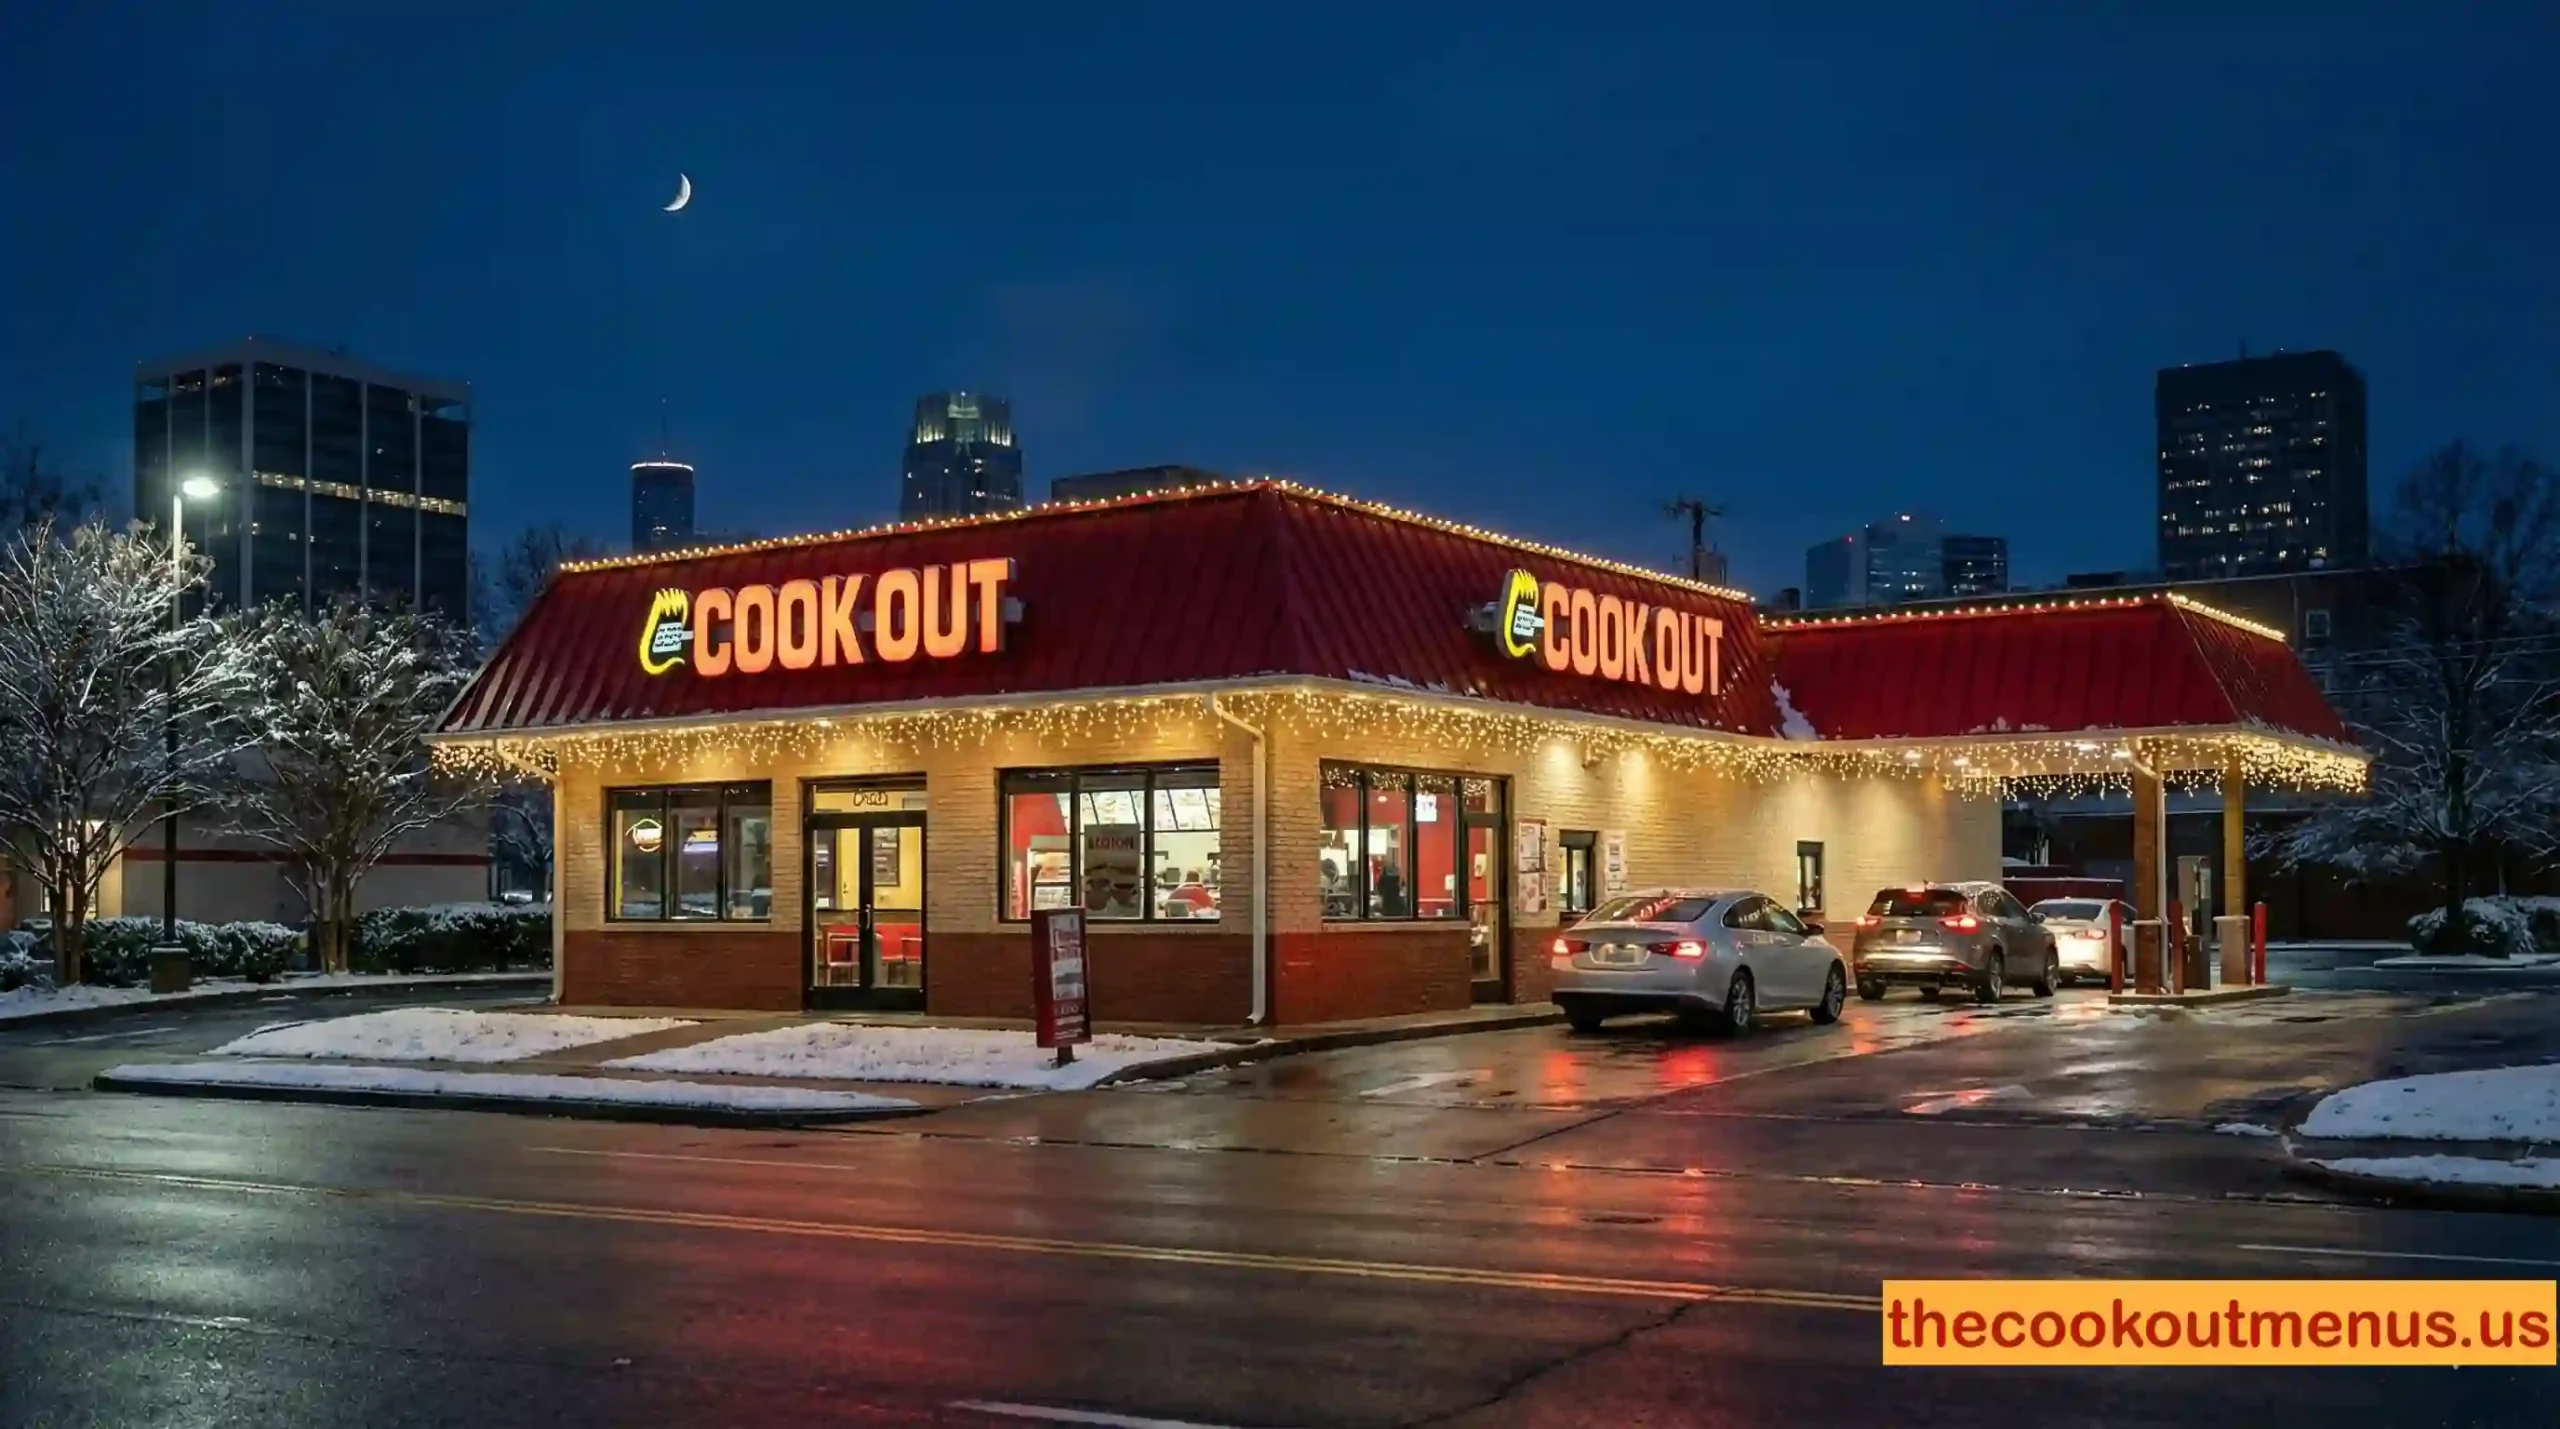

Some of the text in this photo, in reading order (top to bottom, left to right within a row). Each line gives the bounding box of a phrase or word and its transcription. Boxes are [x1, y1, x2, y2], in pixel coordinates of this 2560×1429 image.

[693, 558, 1010, 677] COOK OUT
[1542, 582, 1724, 697] COOK OUT
